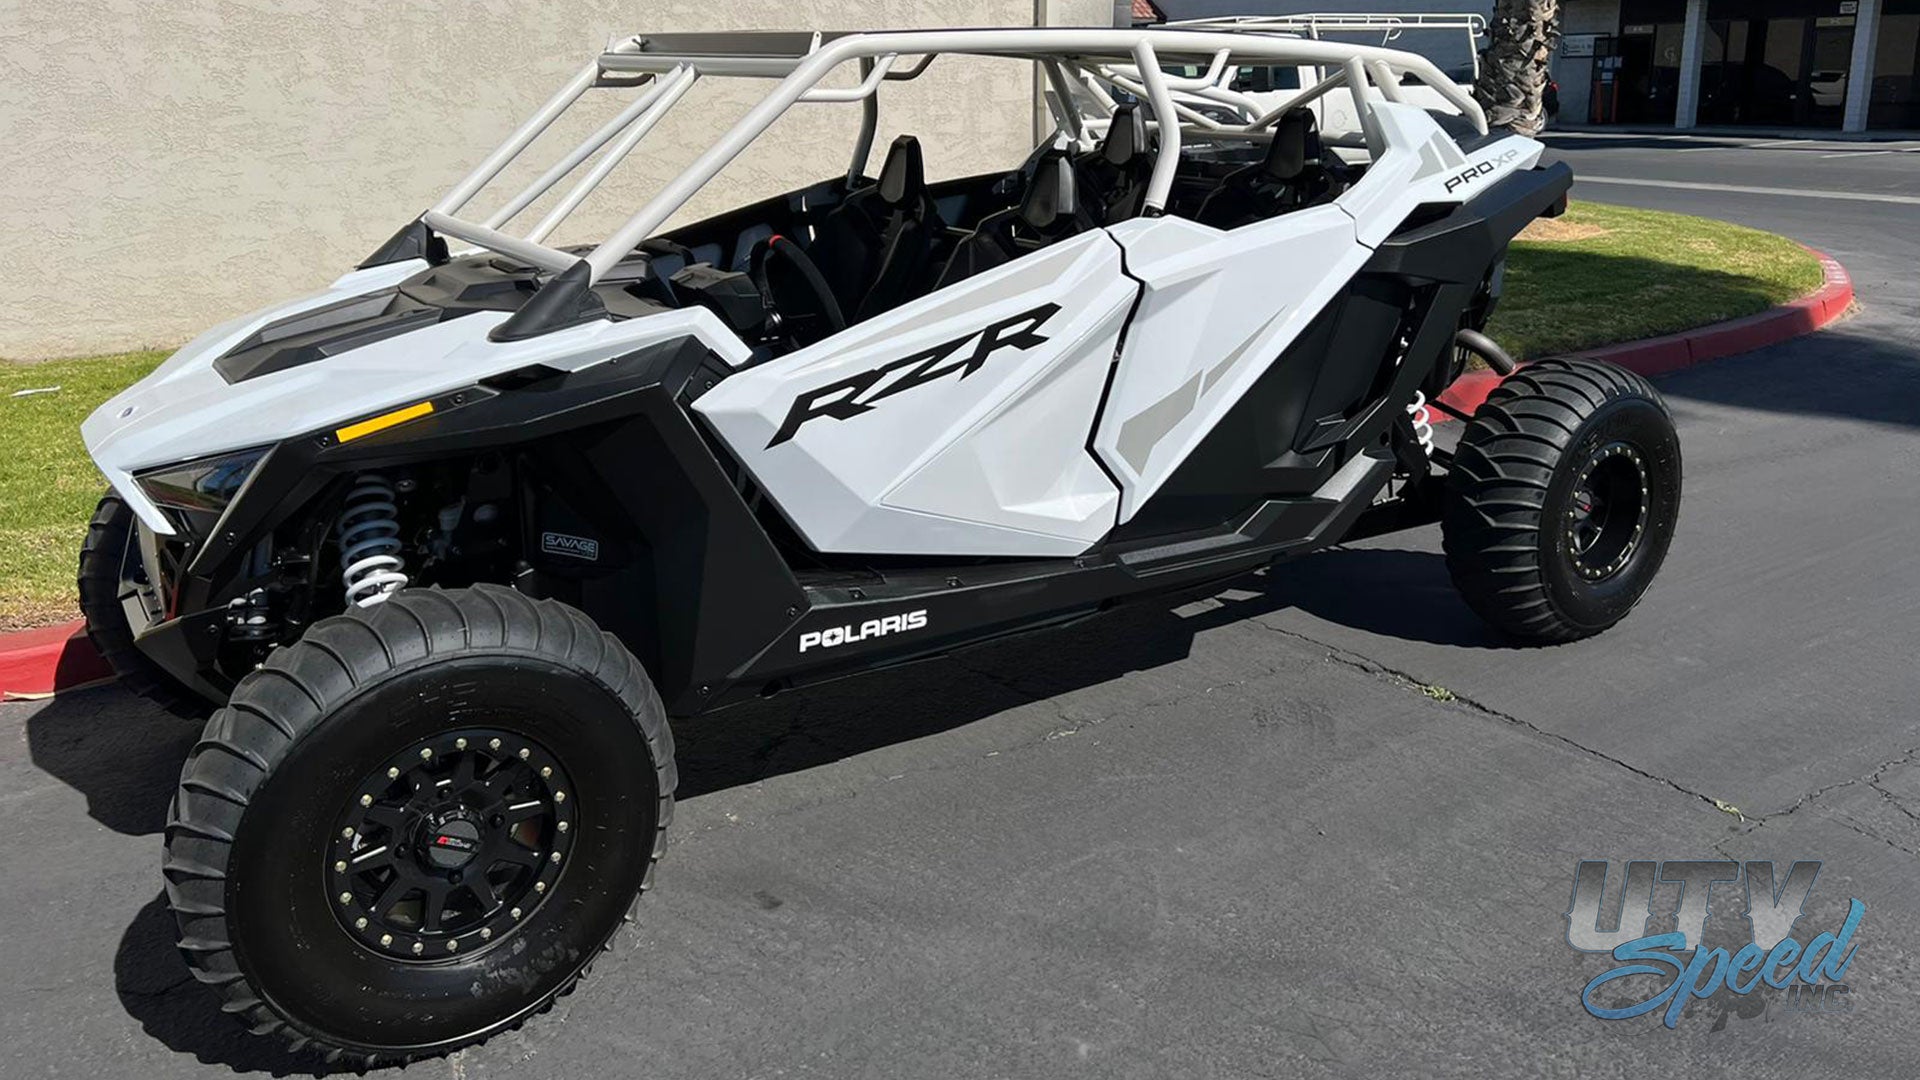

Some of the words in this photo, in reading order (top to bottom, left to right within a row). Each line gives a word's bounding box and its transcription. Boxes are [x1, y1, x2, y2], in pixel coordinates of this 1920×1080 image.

[763, 302, 1063, 451] RZR
[545, 534, 596, 553] SAVAGE
[799, 609, 928, 653] POLARIS
